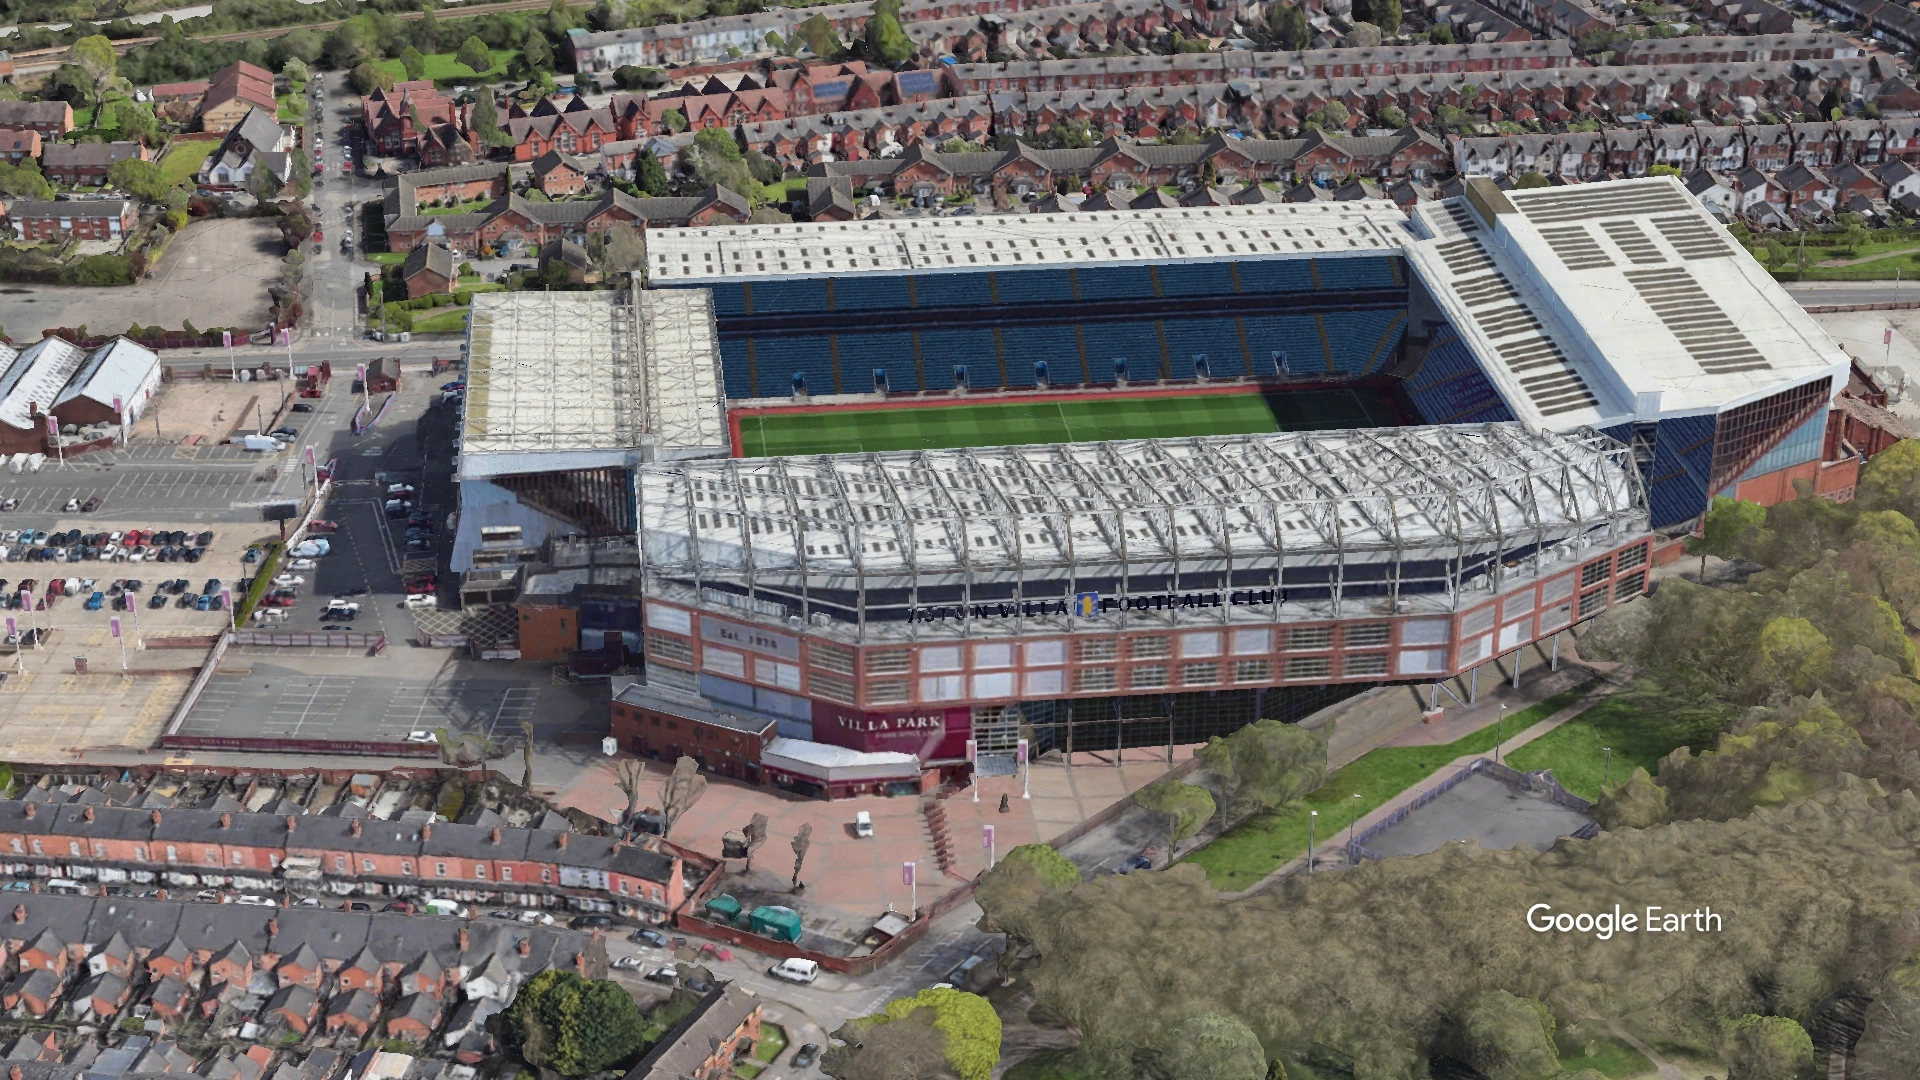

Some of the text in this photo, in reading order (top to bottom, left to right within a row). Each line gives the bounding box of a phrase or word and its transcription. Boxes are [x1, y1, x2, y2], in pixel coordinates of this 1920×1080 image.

[908, 604, 987, 624] ASTON
[997, 600, 1068, 618] VILLA
[1102, 592, 1223, 613] FOOTBALL
[838, 716, 940, 731] VILLA PARK
